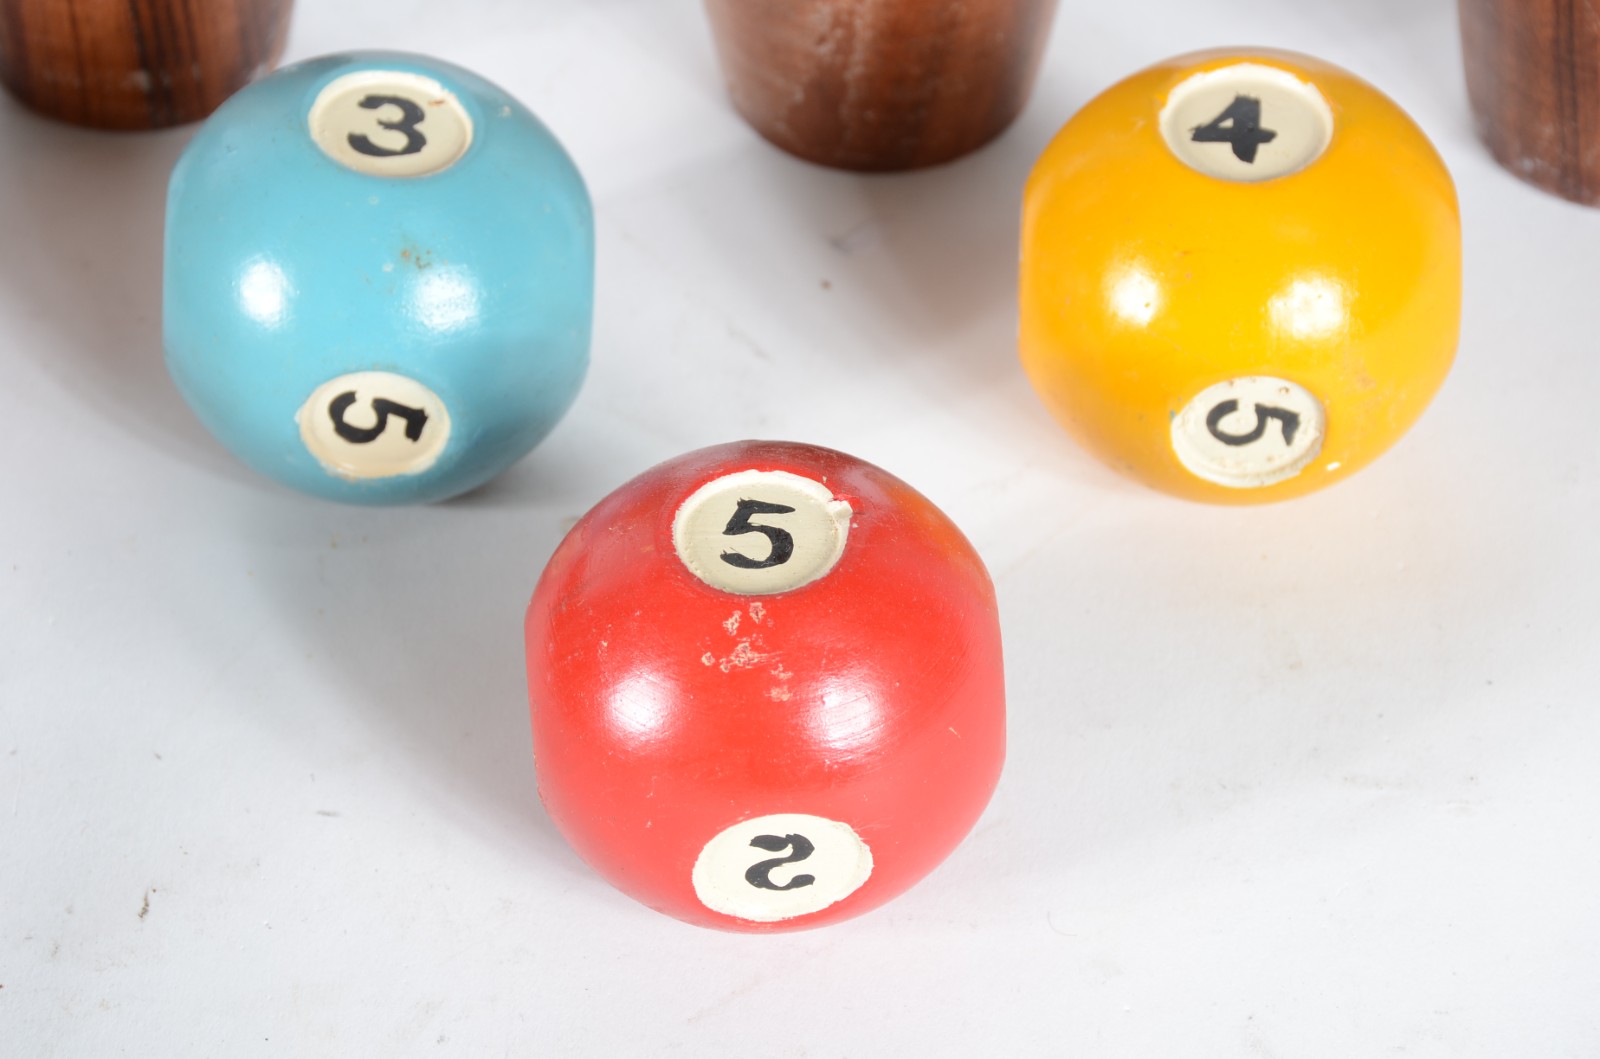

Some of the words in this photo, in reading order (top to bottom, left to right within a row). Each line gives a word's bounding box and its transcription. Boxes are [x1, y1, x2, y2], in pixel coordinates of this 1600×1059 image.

[347, 94, 427, 156] 3
[1191, 95, 1277, 163] 4
[328, 390, 430, 445] 5
[1206, 399, 1300, 447] 5
[719, 498, 796, 569] 5
[745, 833, 816, 891] 2
